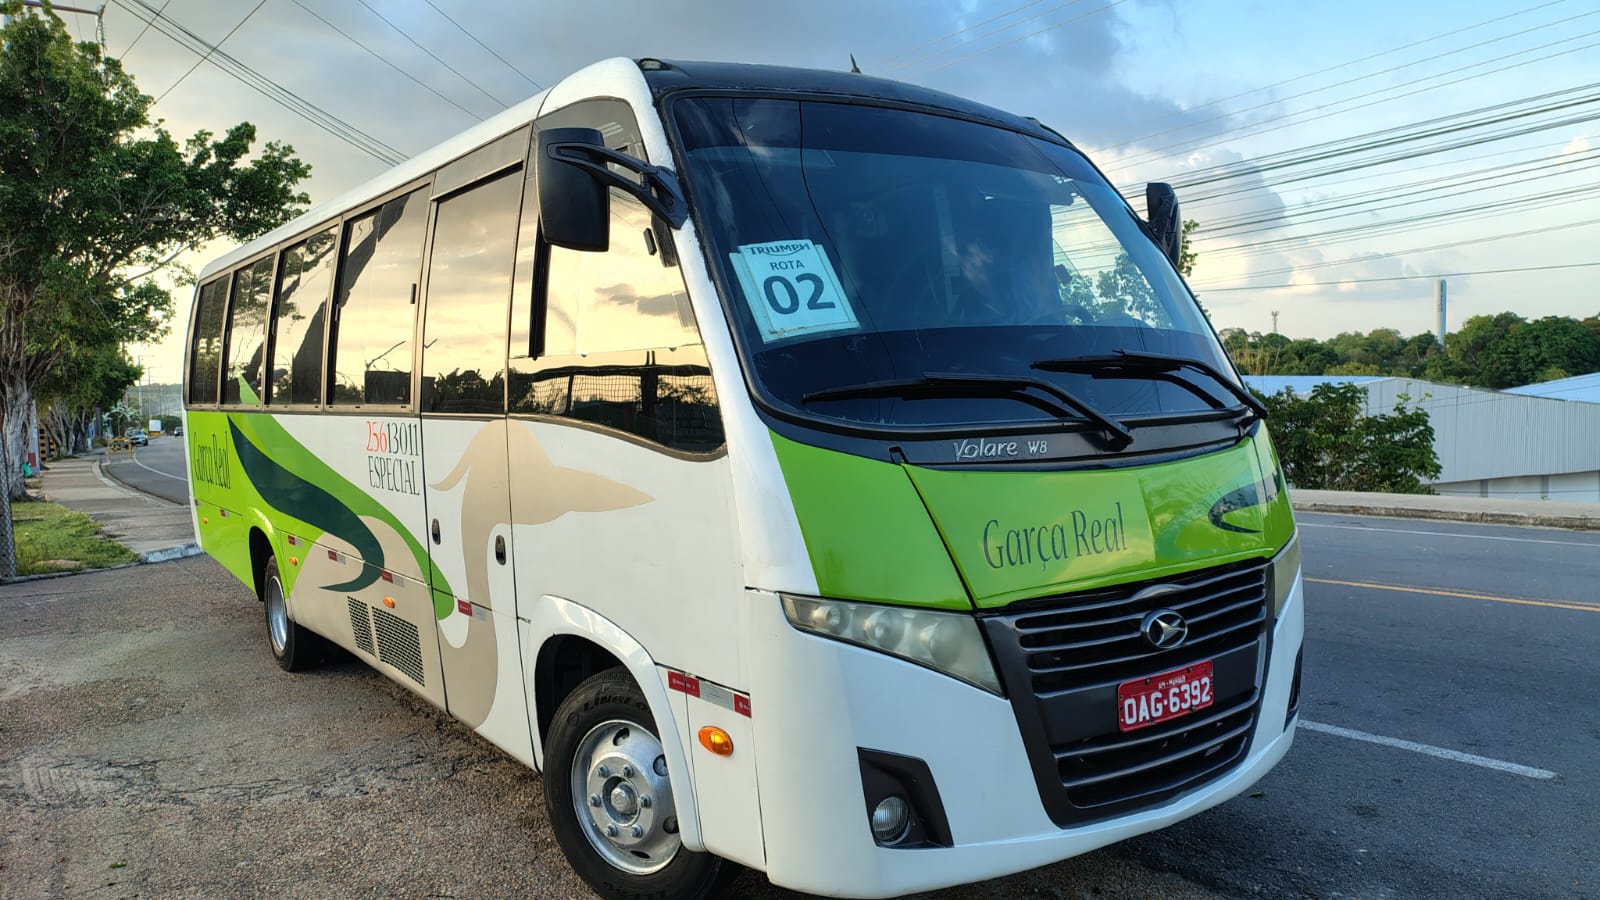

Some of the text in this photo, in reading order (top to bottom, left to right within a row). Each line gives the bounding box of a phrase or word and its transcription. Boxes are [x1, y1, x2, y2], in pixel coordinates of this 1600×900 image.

[750, 242, 811, 255] TRIUMPH
[769, 259, 805, 271] ROTA
[763, 272, 836, 315] 02
[211, 428, 232, 490] Real
[953, 437, 1048, 462] Volare W8
[367, 455, 420, 496] ESPECIAL
[983, 501, 1128, 572] Garça Real
